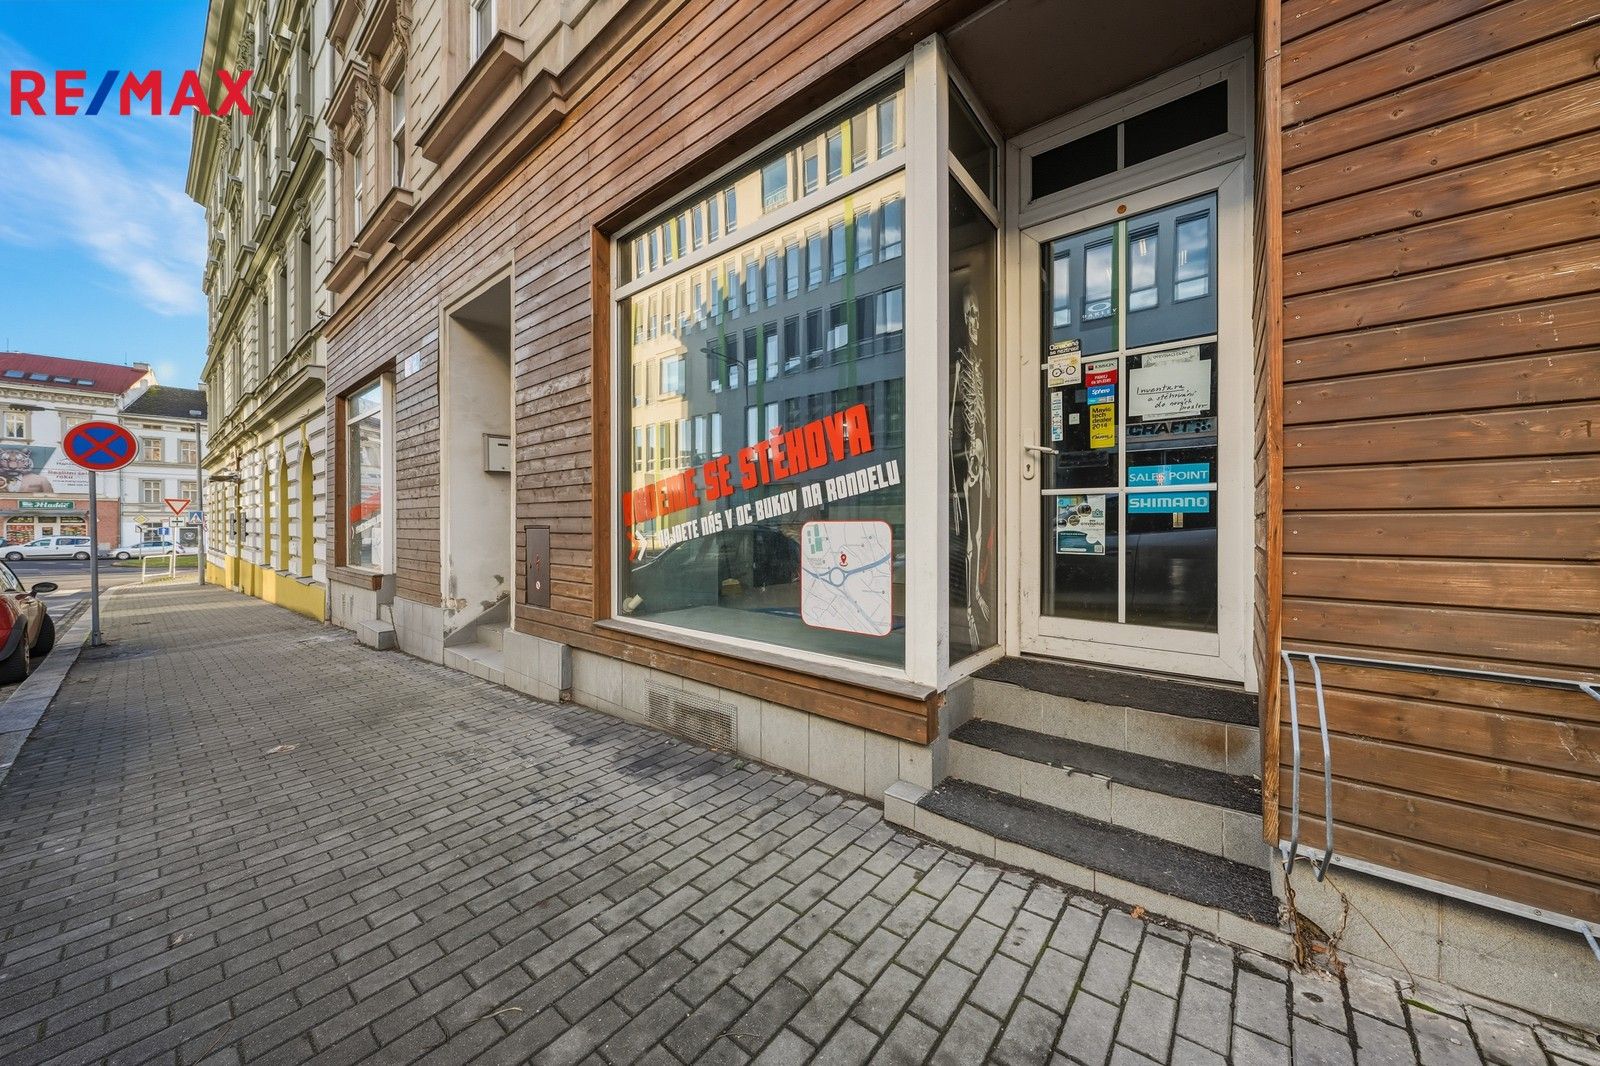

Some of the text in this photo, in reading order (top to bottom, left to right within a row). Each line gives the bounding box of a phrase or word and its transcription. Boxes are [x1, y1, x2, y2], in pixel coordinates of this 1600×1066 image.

[703, 454, 734, 502] SE
[737, 402, 875, 490] STĚHOVA
[701, 511, 723, 535] NÁS
[724, 509, 733, 529] V
[736, 503, 753, 526] OC
[755, 489, 798, 522] BUKOV
[801, 481, 824, 509] NA
[825, 459, 901, 503] RONDELU
[1129, 470, 1208, 482] SALES POINT
[1129, 496, 1208, 508] SHIMANO
